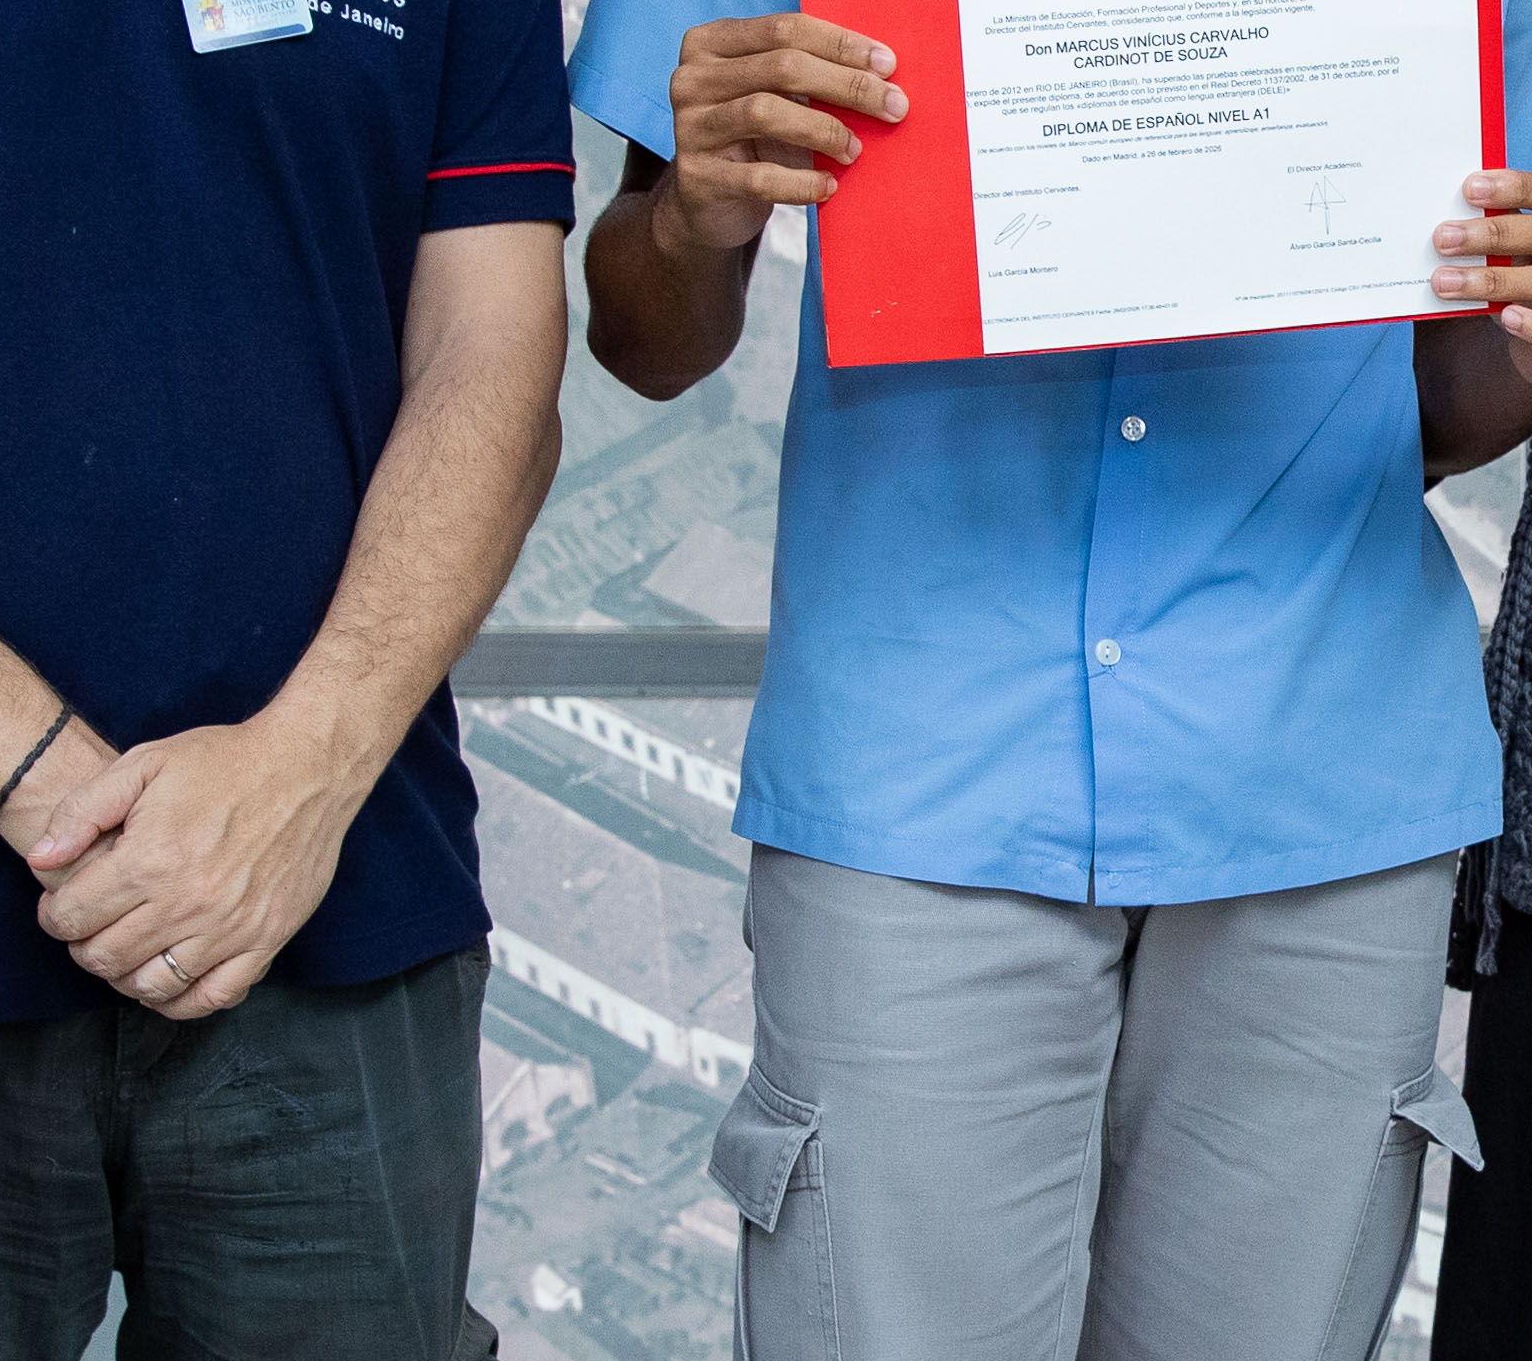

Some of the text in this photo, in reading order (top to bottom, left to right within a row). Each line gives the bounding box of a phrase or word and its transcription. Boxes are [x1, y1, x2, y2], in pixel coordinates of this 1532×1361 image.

[340, 4, 404, 40] Janeiro
[985, 26, 1017, 35] Director
[1018, 24, 1031, 33] del
[1033, 23, 1065, 31] Instituto
[1066, 20, 1110, 29] Cervantes,
[1111, 15, 1165, 26] considerando
[1166, 15, 1184, 23] que,
[1186, 12, 1223, 21] conforme
[1241, 6, 1283, 18] legislación
[1284, 4, 1315, 14] vigente,
[993, 16, 1004, 24] La
[1005, 15, 1037, 23] Ministra
[1051, 10, 1095, 20] Educación,
[1097, 7, 1140, 17] Formación
[1141, 3, 1186, 13] Profesional
[1194, 1, 1231, 10] Deportes
[1025, 26, 1269, 56] Don MARCUS VINÍCIUS CARVALHO
[1074, 46, 1228, 69] CARDINOT DE SOUZA
[966, 90, 988, 98] brero
[989, 88, 1000, 96] de
[1001, 86, 1022, 95] 2012
[1036, 83, 1052, 92] RIO
[1054, 82, 1066, 91] DE
[1069, 80, 1107, 90] JANEIRO
[1109, 78, 1140, 88] (Brasil),
[1154, 74, 1191, 84] superado
[1192, 73, 1205, 81] las
[1206, 71, 1239, 81] pruebas
[1240, 67, 1283, 77] celebradas
[1296, 63, 1338, 72] noviembre
[1351, 59, 1371, 68] 2025
[1384, 56, 1400, 65] RÍO
[974, 99, 1001, 108] expide
[1002, 97, 1010, 105] el
[1012, 95, 1047, 106] presente
[1049, 93, 1082, 102] diploma,
[1097, 89, 1129, 98] acuerdo
[1130, 88, 1146, 96] con
[1147, 86, 1155, 94] lo
[1156, 85, 1188, 95] previsto
[1201, 82, 1209, 90] el
[1211, 81, 1229, 89] Real
[1231, 79, 1262, 88] Decreto
[1264, 74, 1307, 85] 1137/2002,
[1321, 72, 1330, 81] 31
[1332, 72, 1343, 80] de
[1344, 70, 1376, 79] octubre,
[1377, 69, 1390, 77] por
[1392, 67, 1399, 75] el
[1002, 108, 1017, 116] que
[1031, 104, 1061, 114] regulan
[1063, 103, 1075, 111] los
[1131, 95, 1163, 106] español
[1164, 95, 1186, 103] como
[1188, 93, 1215, 102] lengua
[1216, 90, 1256, 99] extranjera
[1043, 107, 1269, 137] DIPLOMA DE ESPAÑOL NIVEL A1
